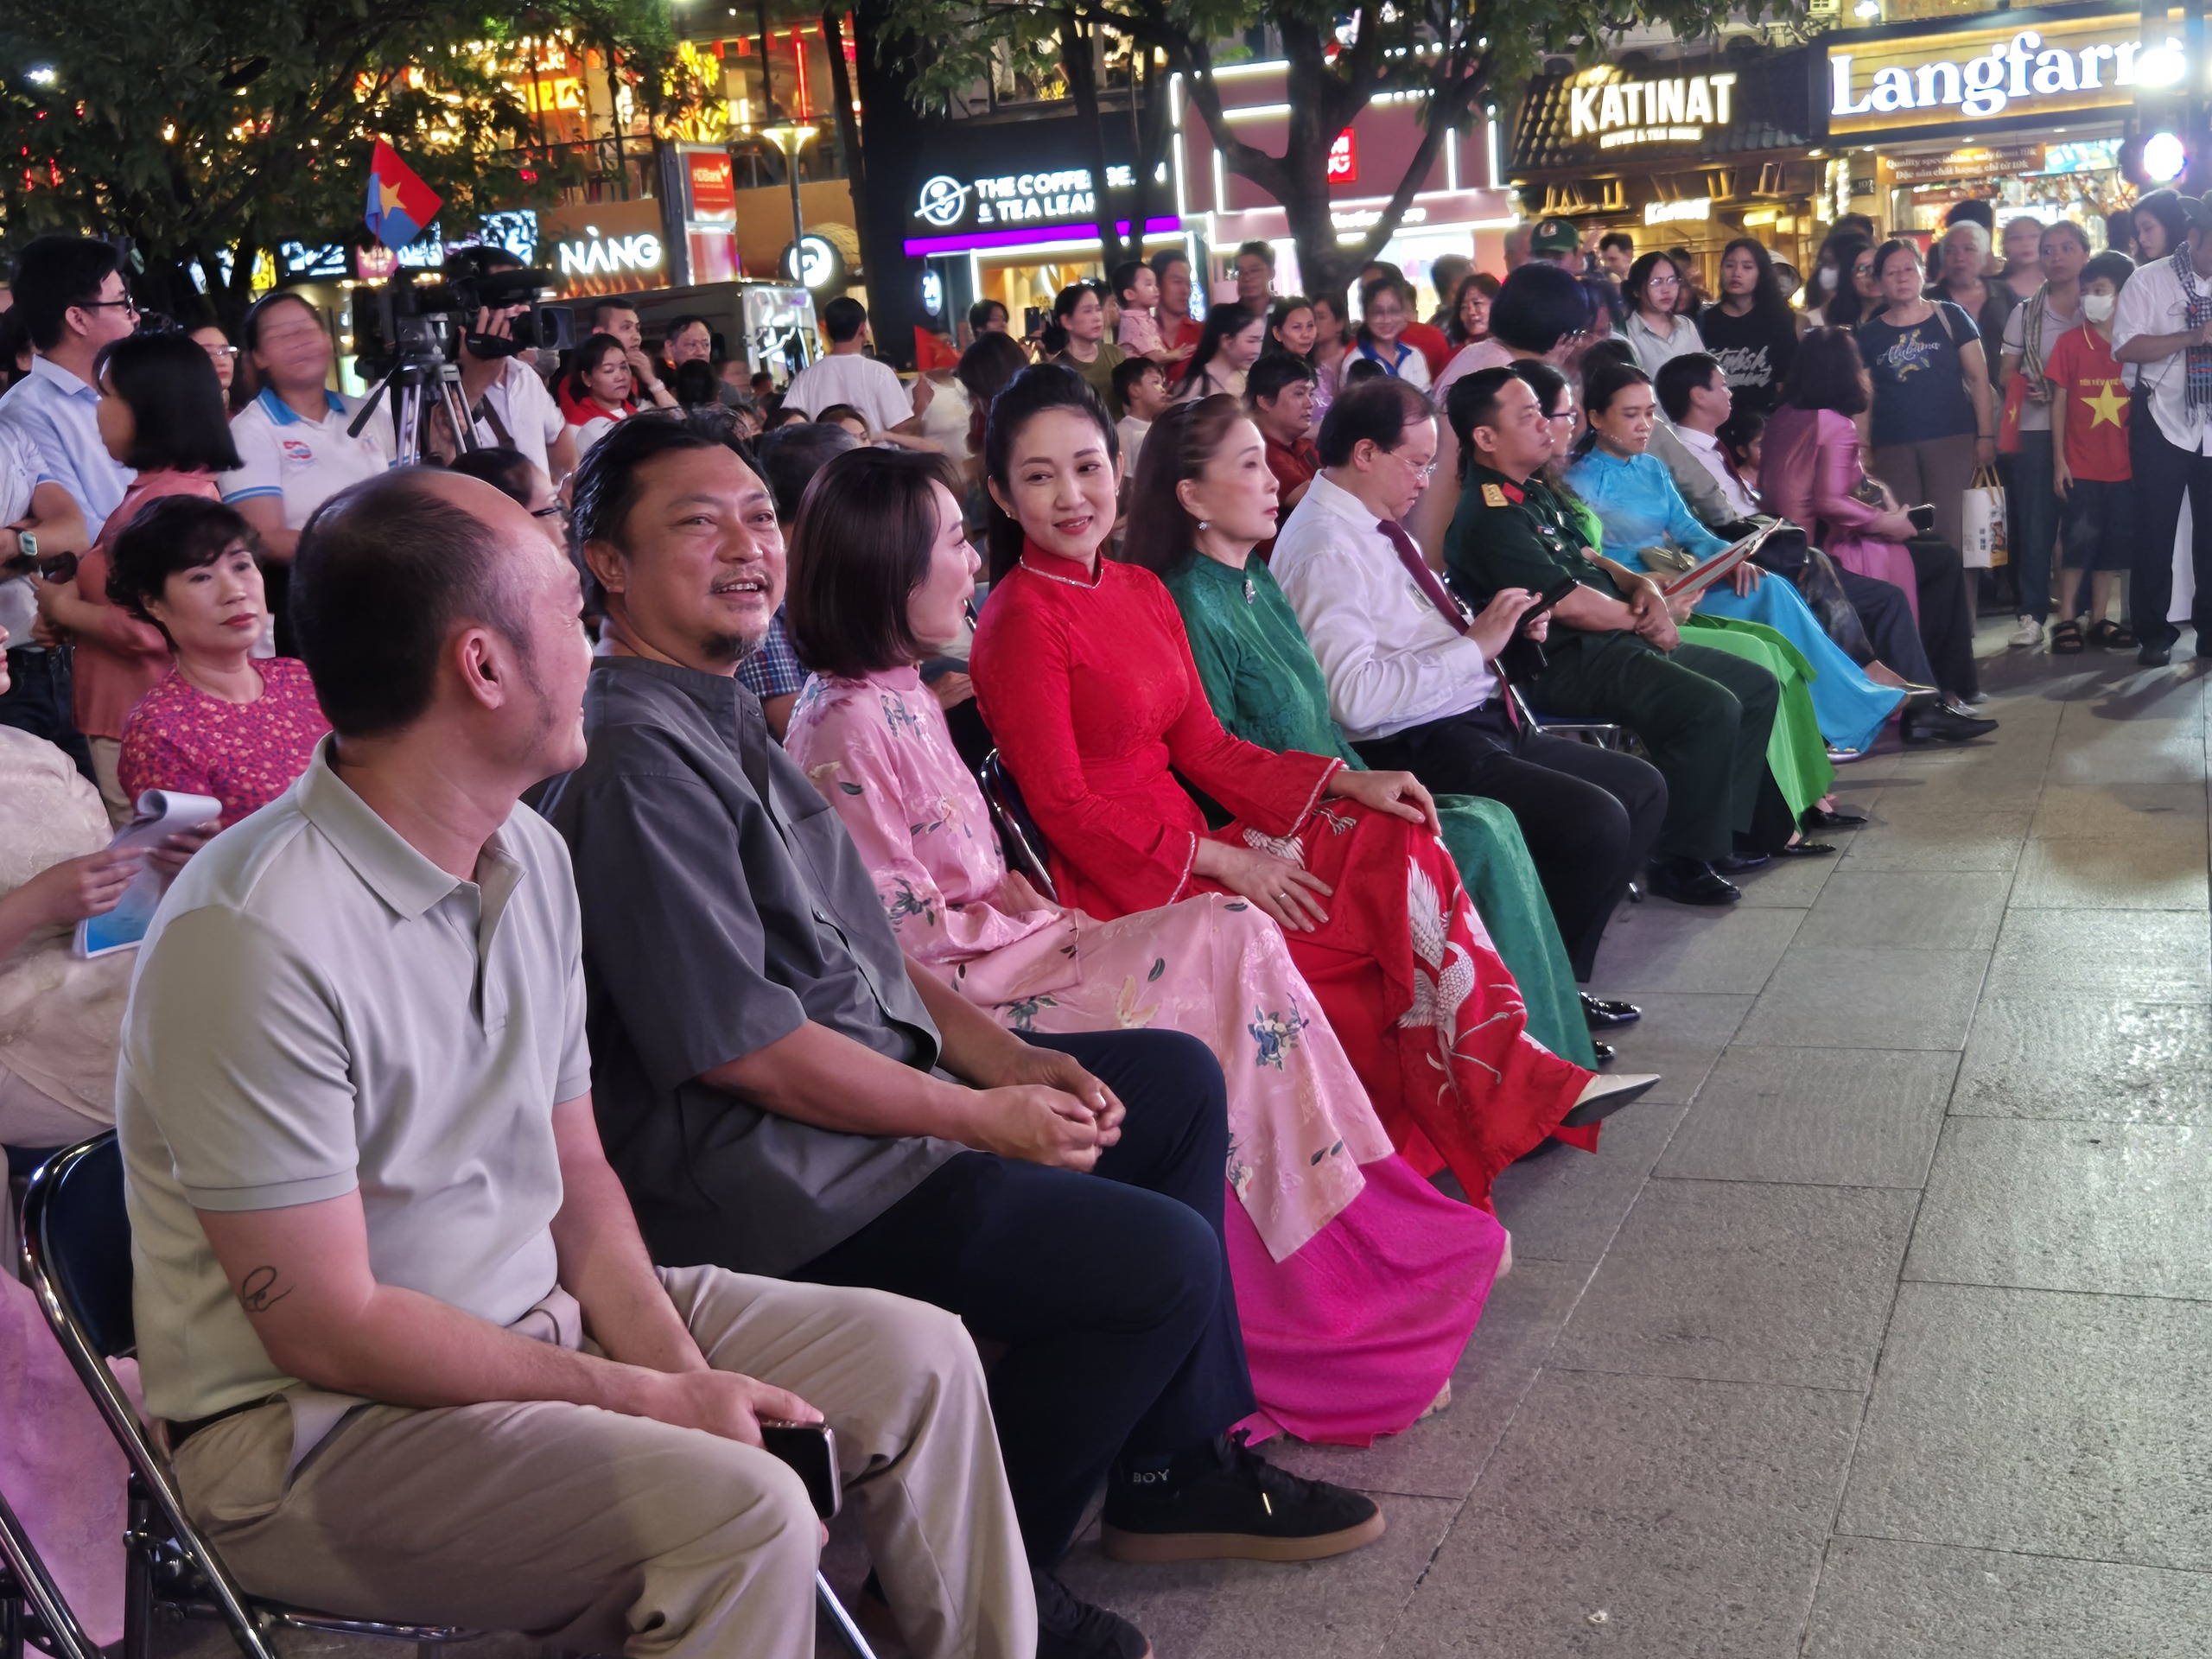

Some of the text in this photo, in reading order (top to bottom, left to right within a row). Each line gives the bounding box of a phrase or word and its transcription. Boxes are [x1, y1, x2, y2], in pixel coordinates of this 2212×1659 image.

[1571, 73, 1737, 137] KATINAT
[975, 176, 1016, 199] THE
[996, 198, 1042, 221] TEA
[558, 226, 662, 275] NÀNG
[1133, 1468, 1170, 1484] BOY
